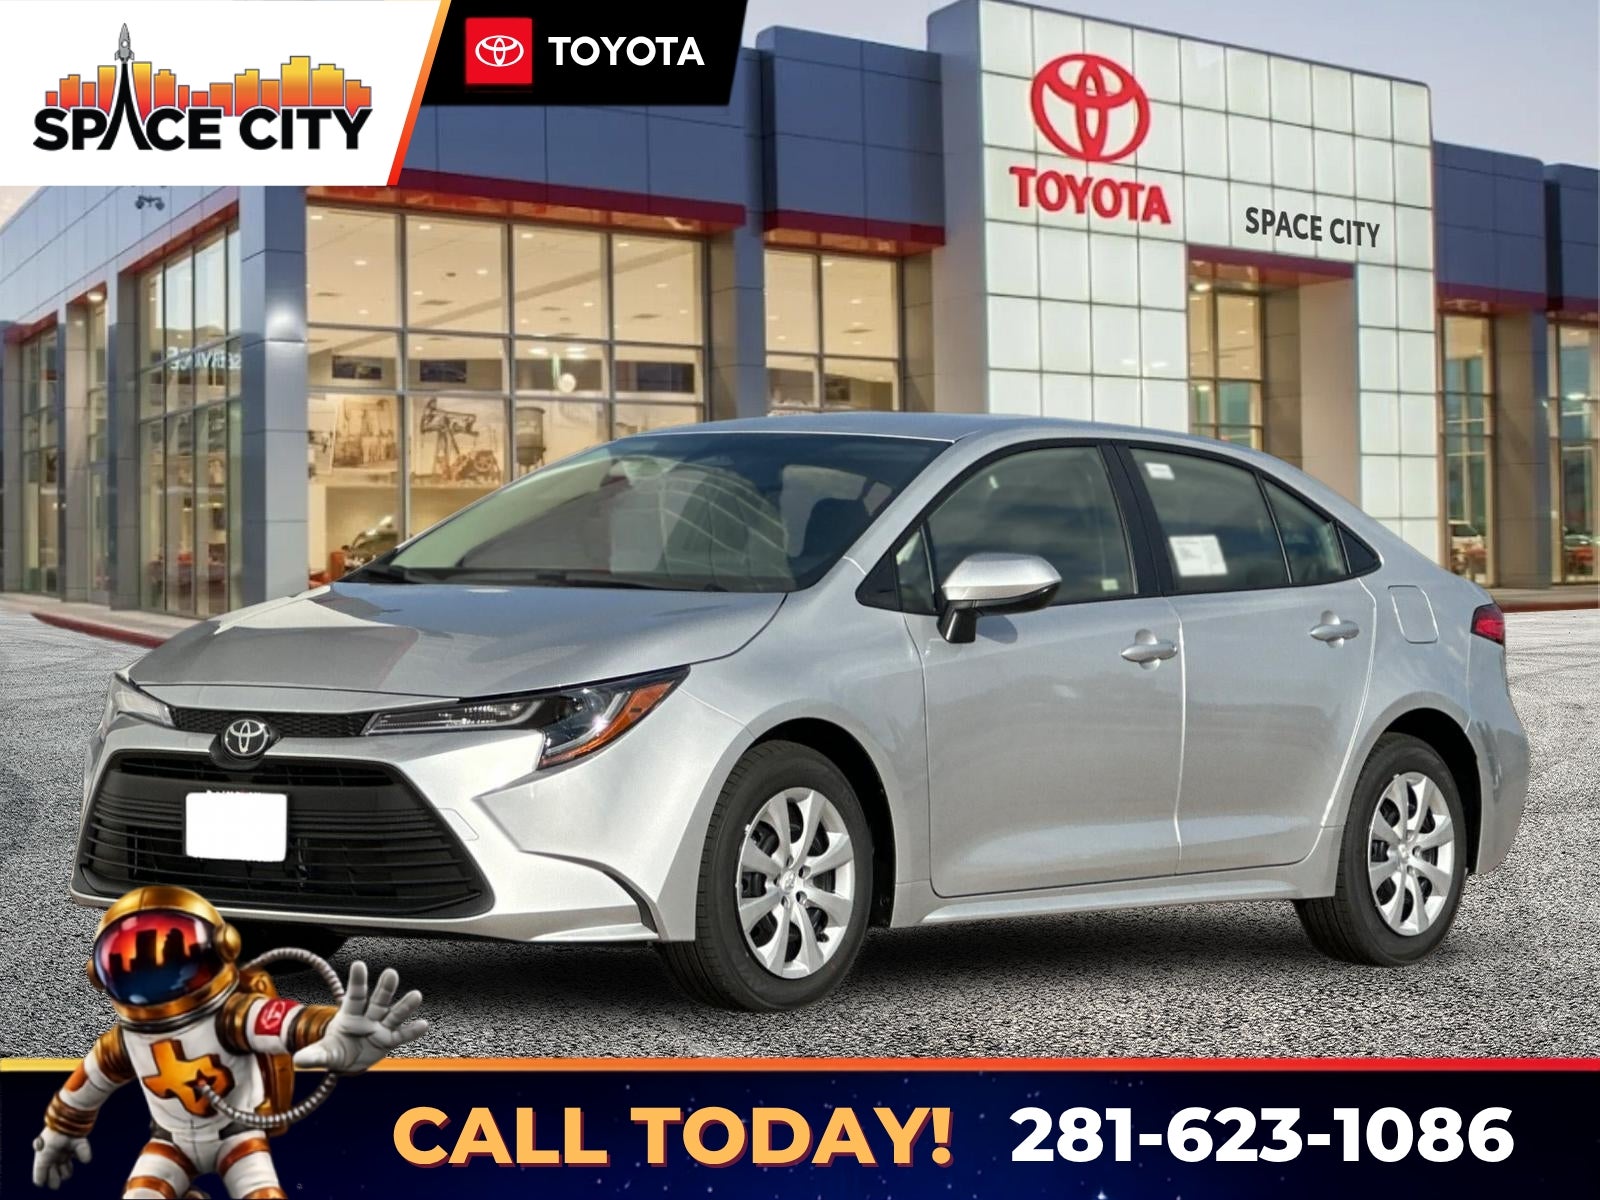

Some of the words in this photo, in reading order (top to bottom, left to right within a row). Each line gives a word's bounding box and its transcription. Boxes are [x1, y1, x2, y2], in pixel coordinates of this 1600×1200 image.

[1009, 165, 1171, 224] TOYOTA
[1245, 206, 1323, 242] SPACE
[1329, 218, 1380, 248] CITY
